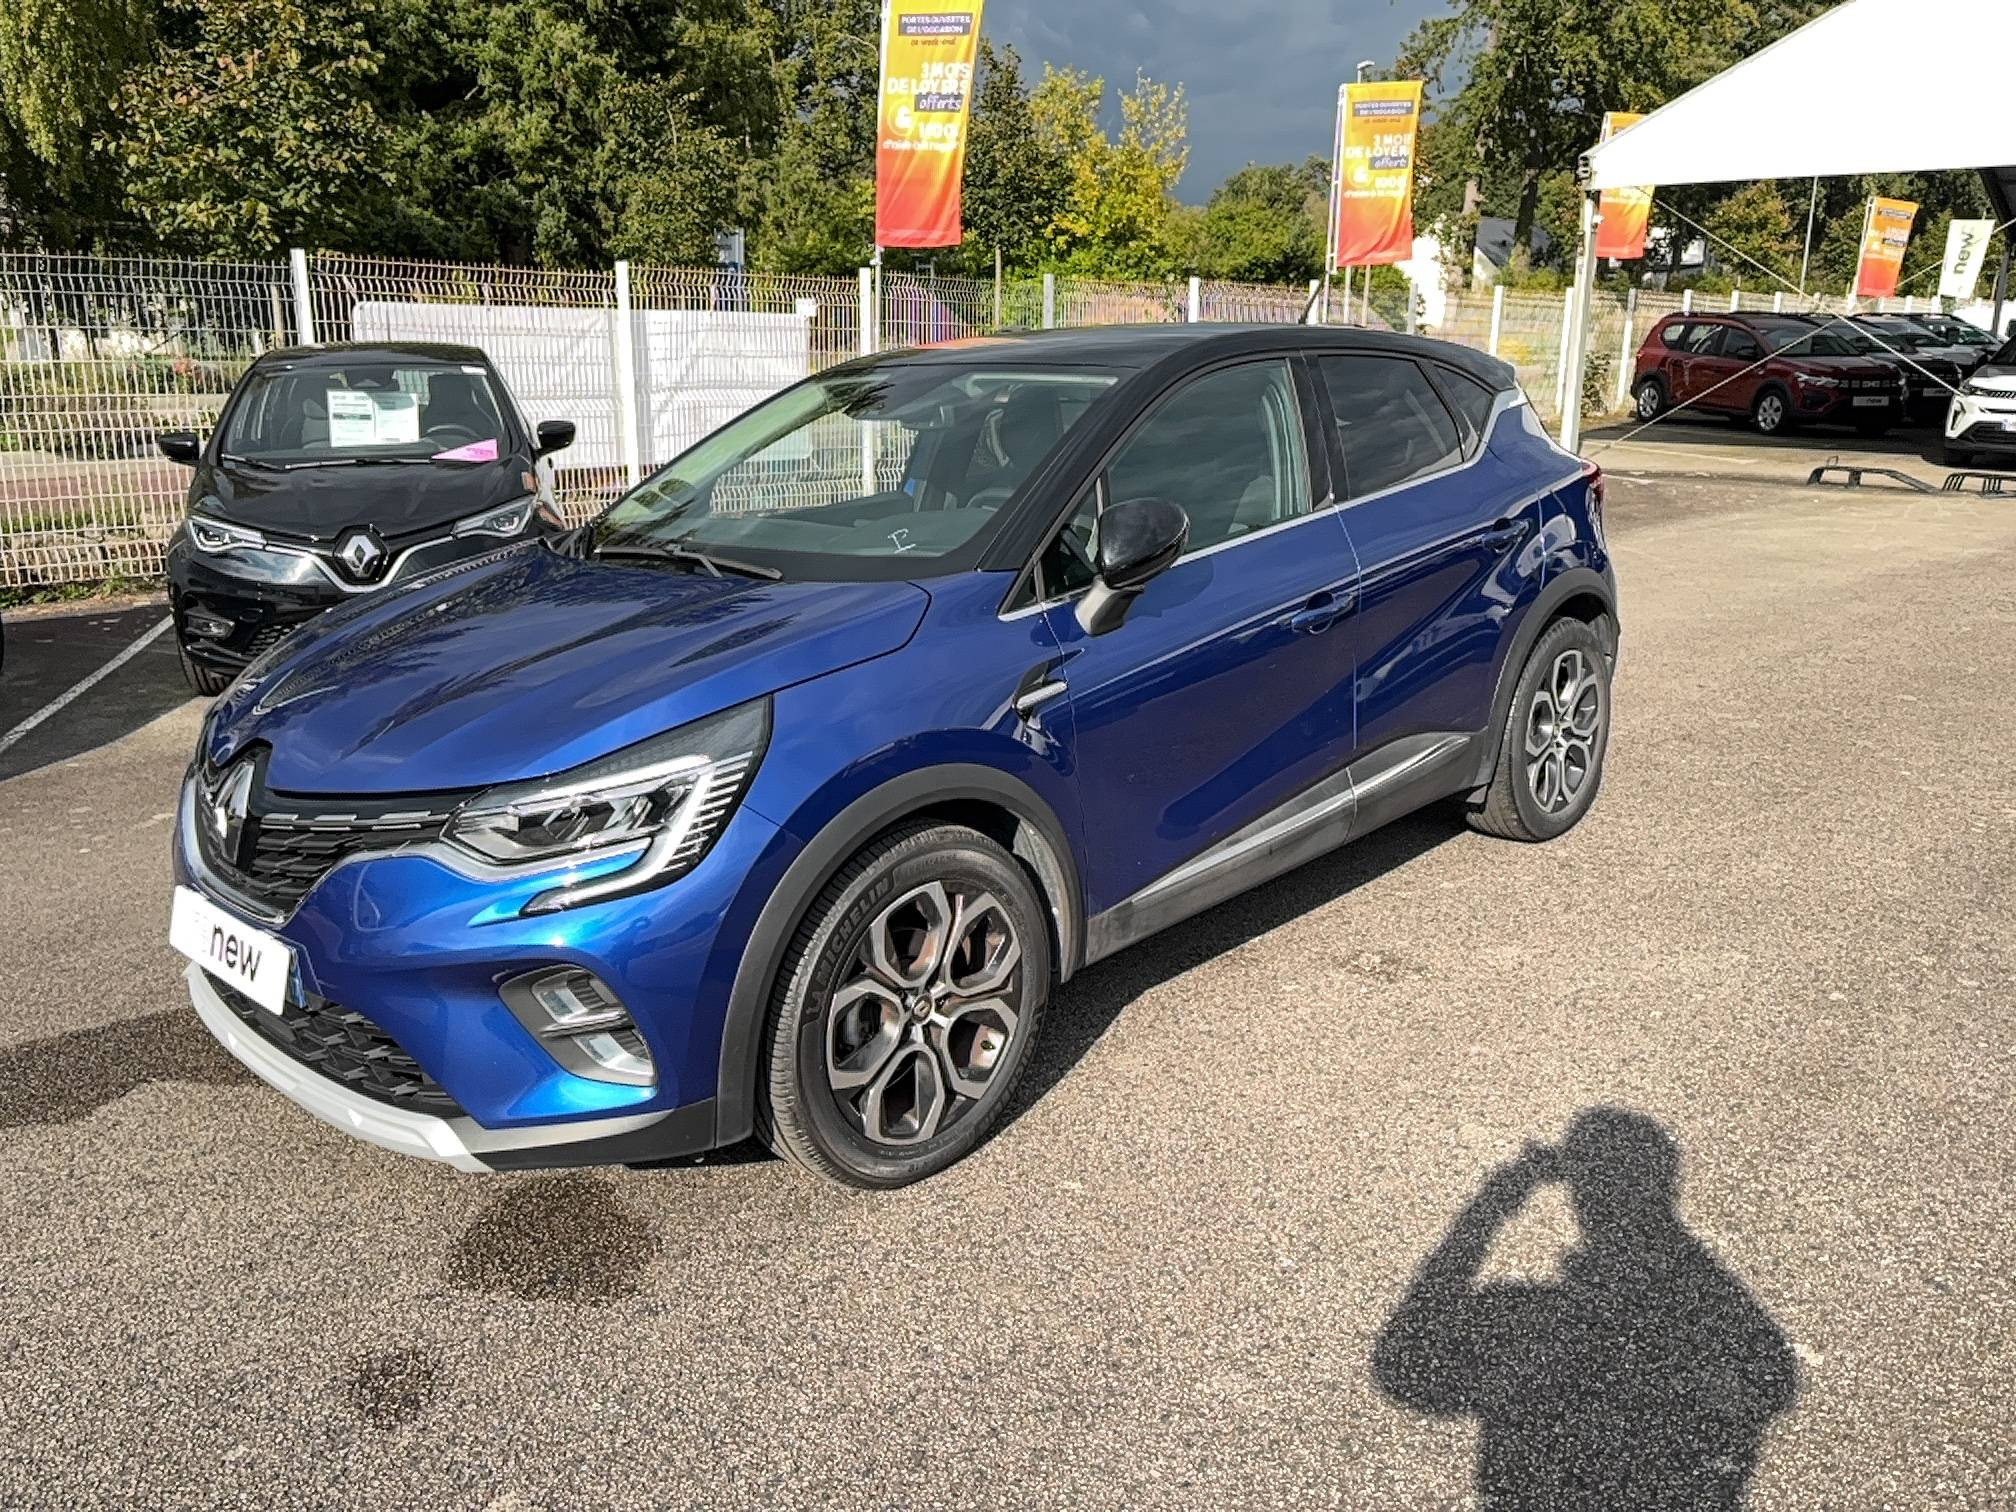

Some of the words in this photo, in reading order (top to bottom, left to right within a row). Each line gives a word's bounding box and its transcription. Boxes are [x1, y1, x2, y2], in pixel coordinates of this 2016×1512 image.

[931, 62, 970, 80] MOIS
[887, 78, 910, 95] DE
[911, 78, 968, 96] LOYERS
[919, 94, 961, 112] offerts
[1953, 230, 1975, 275] new
[813, 874, 893, 986] MICHELIN
[209, 923, 262, 982] new
